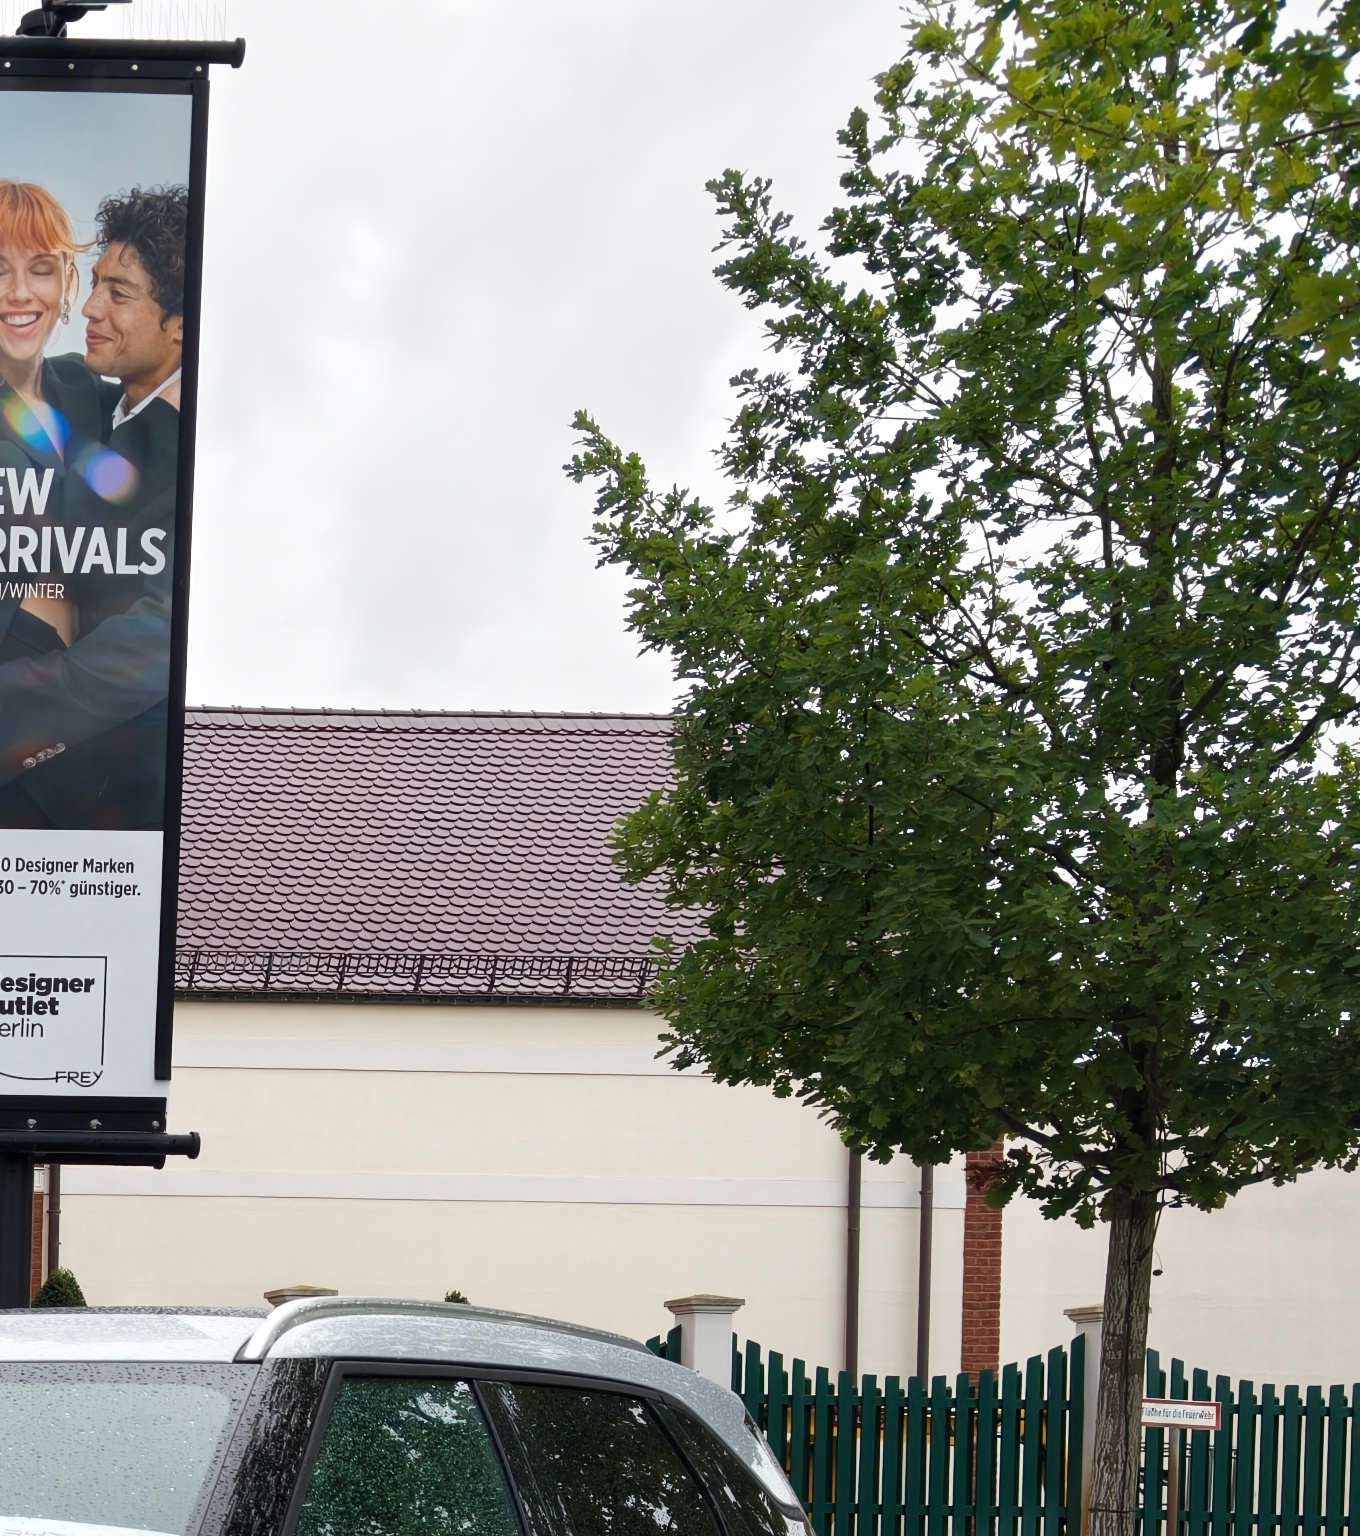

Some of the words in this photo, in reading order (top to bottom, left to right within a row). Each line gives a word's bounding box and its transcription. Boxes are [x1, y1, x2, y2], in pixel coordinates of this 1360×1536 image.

[15, 858, 79, 875] Designer
[82, 858, 134, 874] Marken
[69, 881, 141, 897] günstiger.
[55, 1070, 103, 1087] FREY
[1162, 1408, 1171, 1417] für
[1173, 1409, 1181, 1418] die
